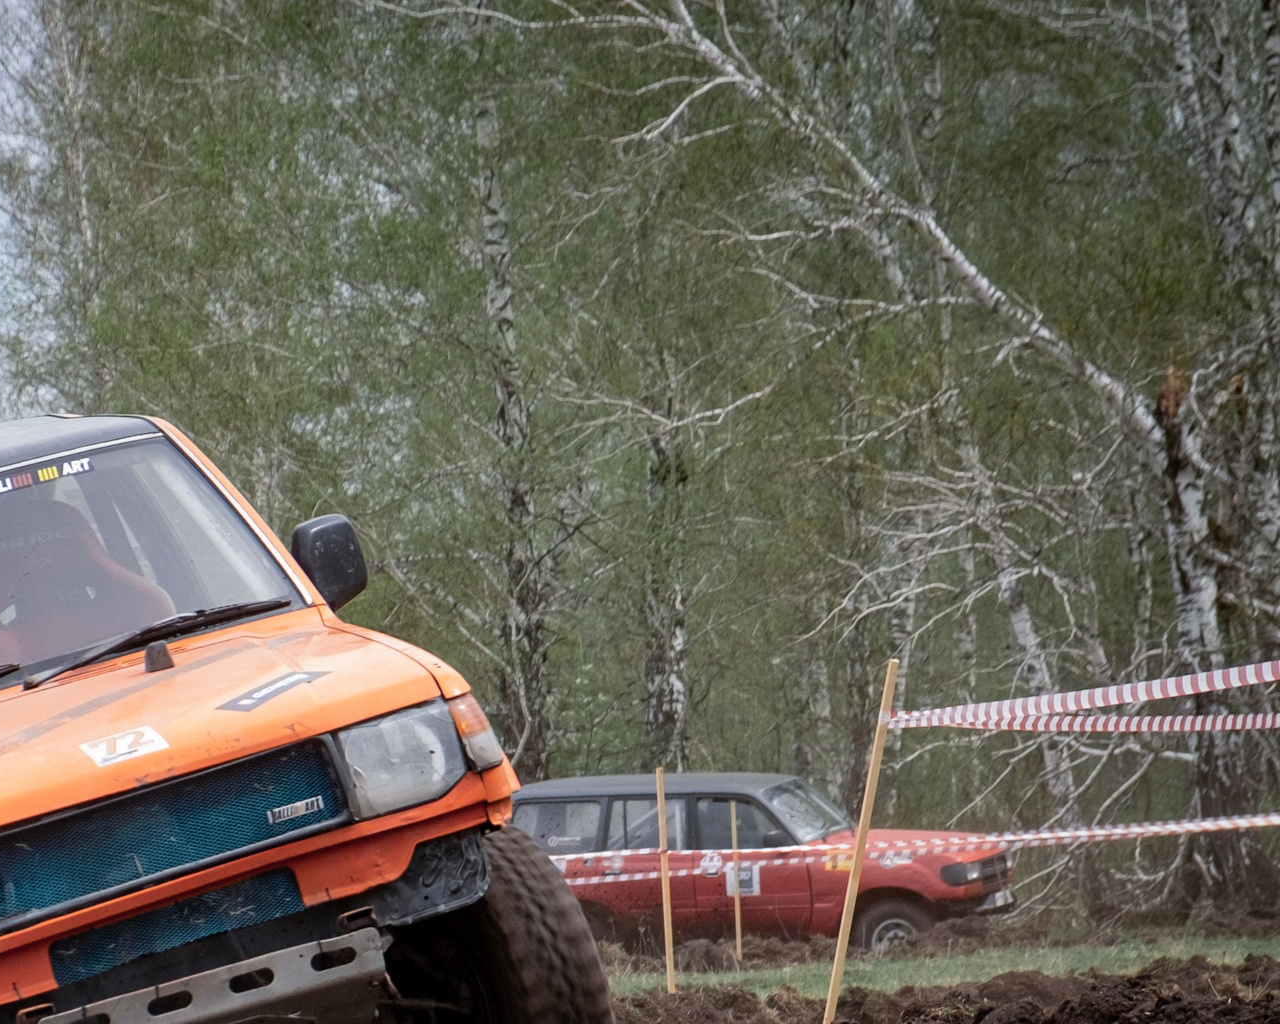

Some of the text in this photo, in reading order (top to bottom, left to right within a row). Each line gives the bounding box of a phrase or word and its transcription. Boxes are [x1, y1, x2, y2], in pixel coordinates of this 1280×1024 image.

[62, 457, 91, 476] ART
[87, 730, 155, 757] 72
[305, 797, 321, 812] ART
